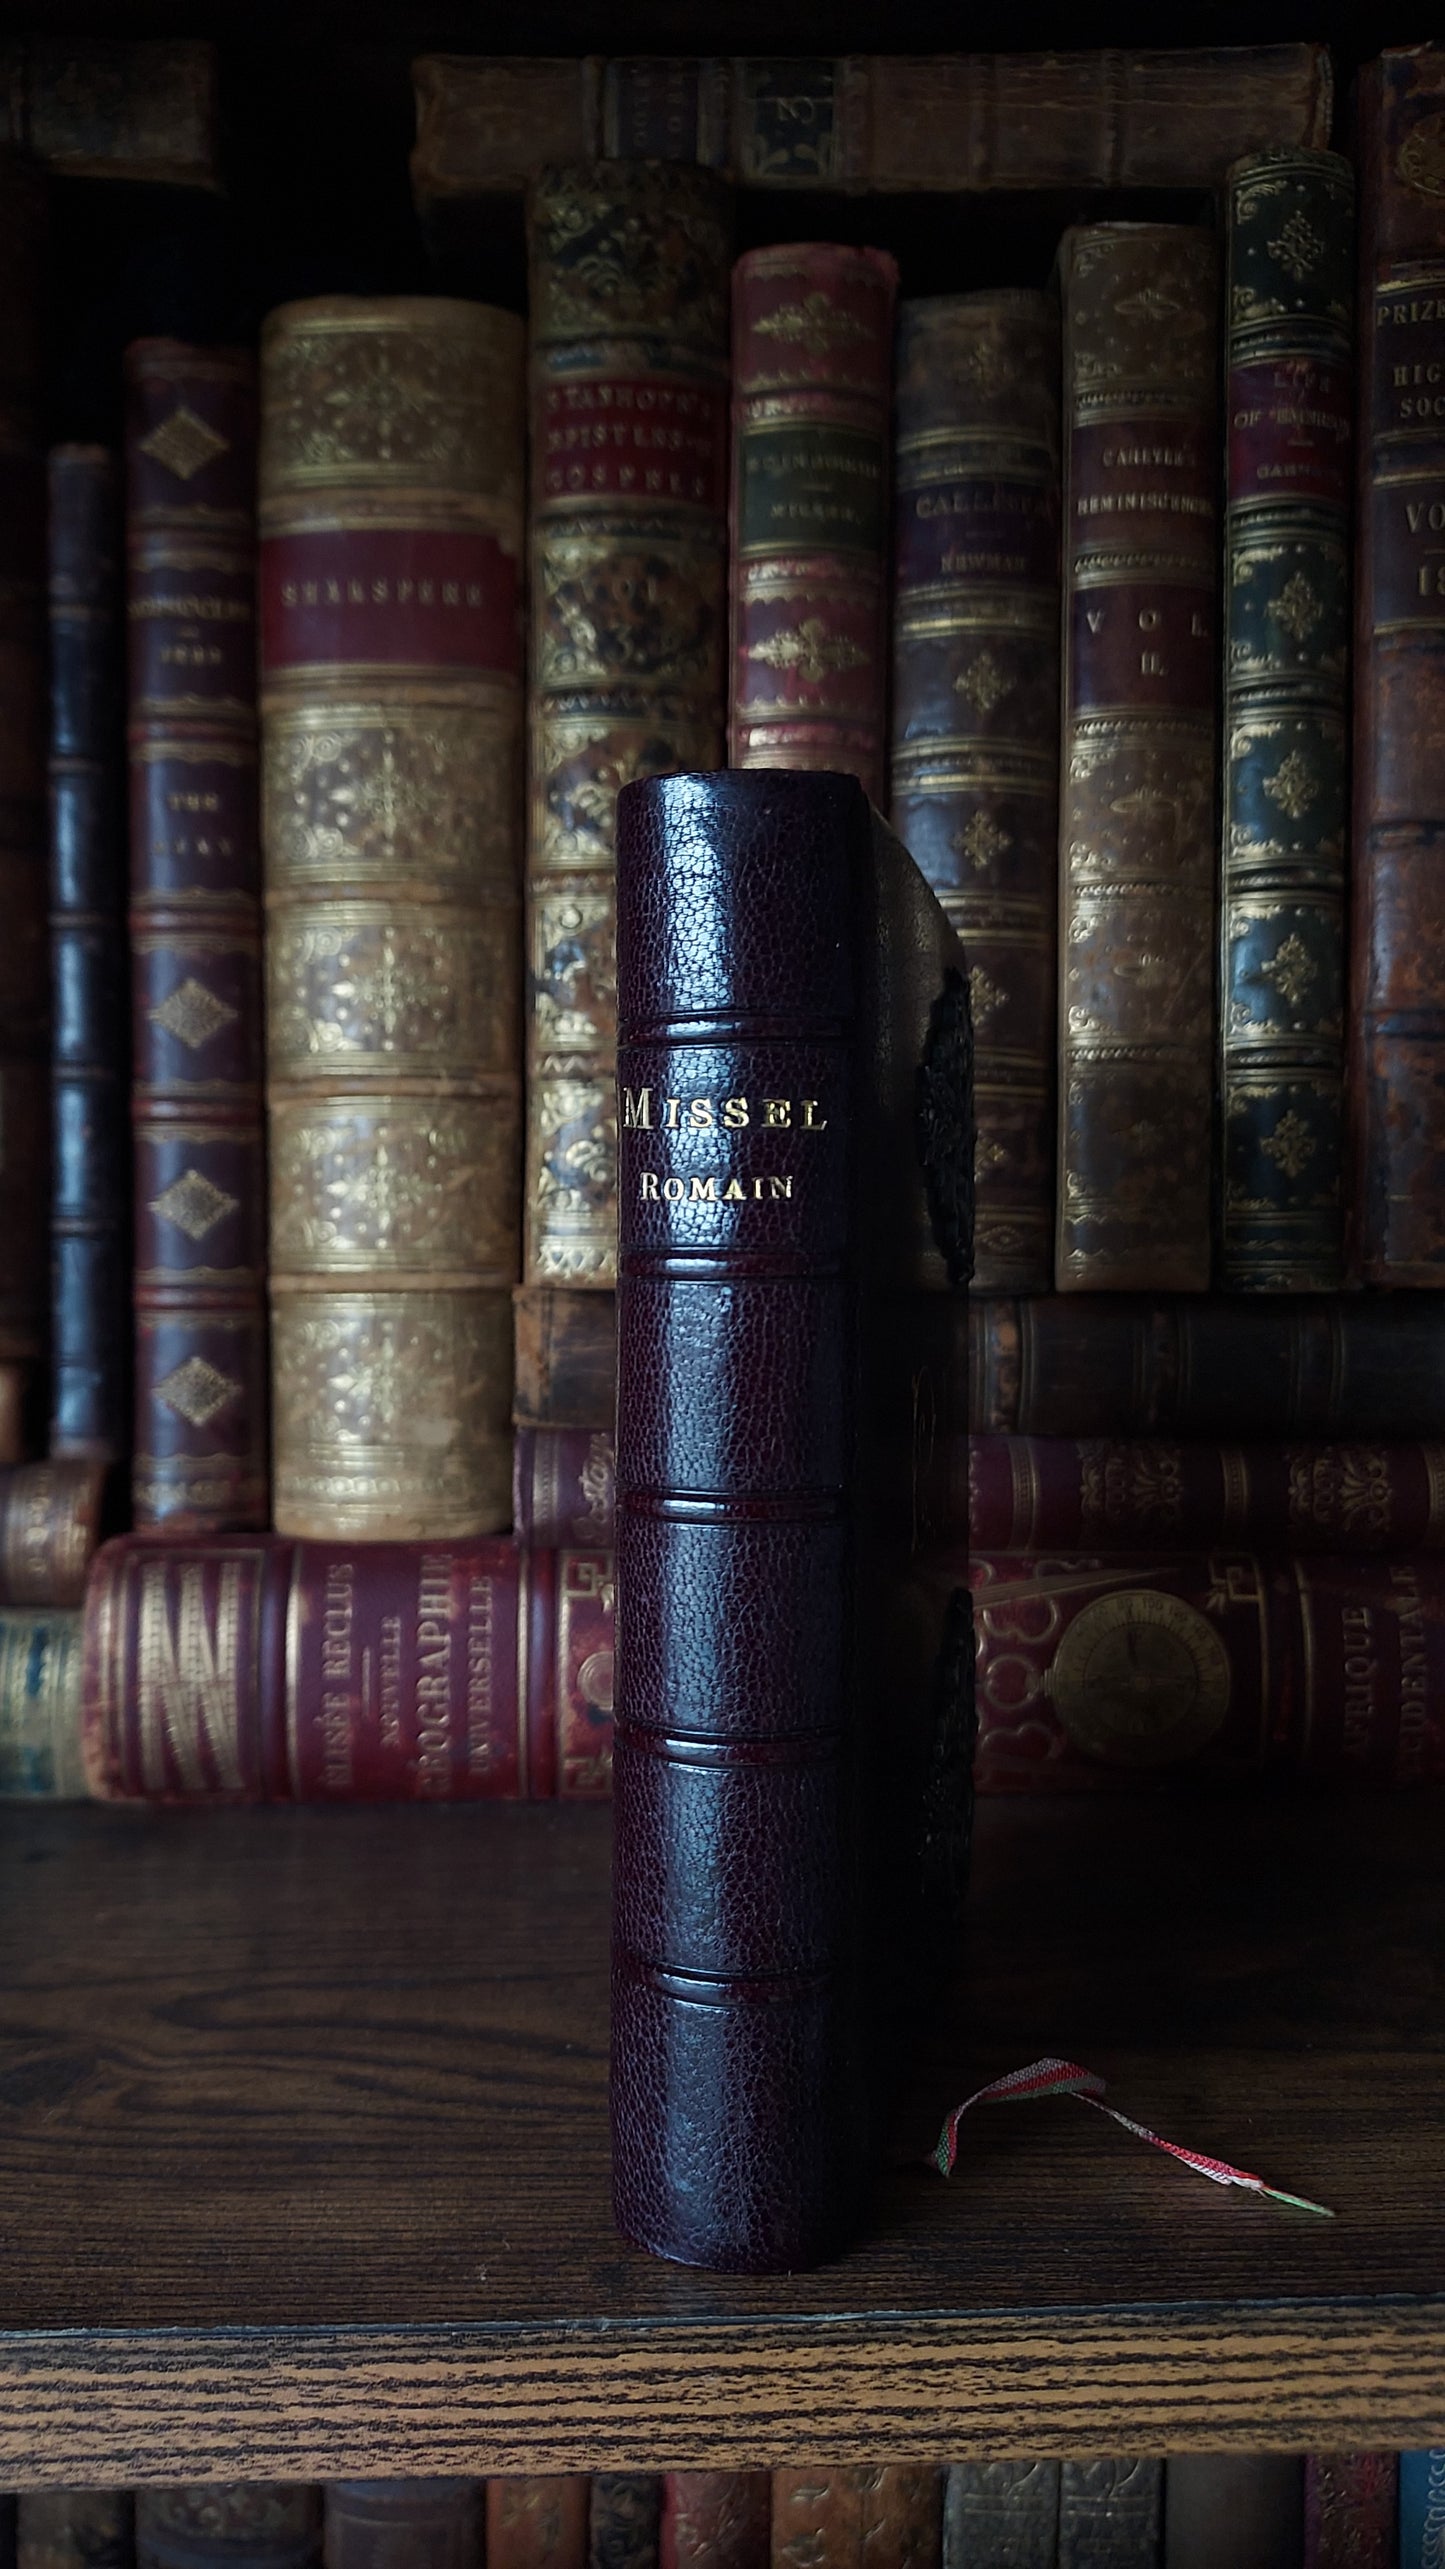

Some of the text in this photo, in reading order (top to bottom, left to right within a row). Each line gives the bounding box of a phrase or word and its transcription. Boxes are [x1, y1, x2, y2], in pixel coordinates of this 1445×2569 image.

[546, 462, 707, 498] GOSPELS
[623, 1087, 828, 1130] MISSEL
[640, 1171, 793, 1201] ROMAIN
[321, 1563, 354, 1681] RECLUS
[379, 1616, 401, 1750] NOUVELLE
[468, 1575, 493, 1777] UNIVERSELLE
